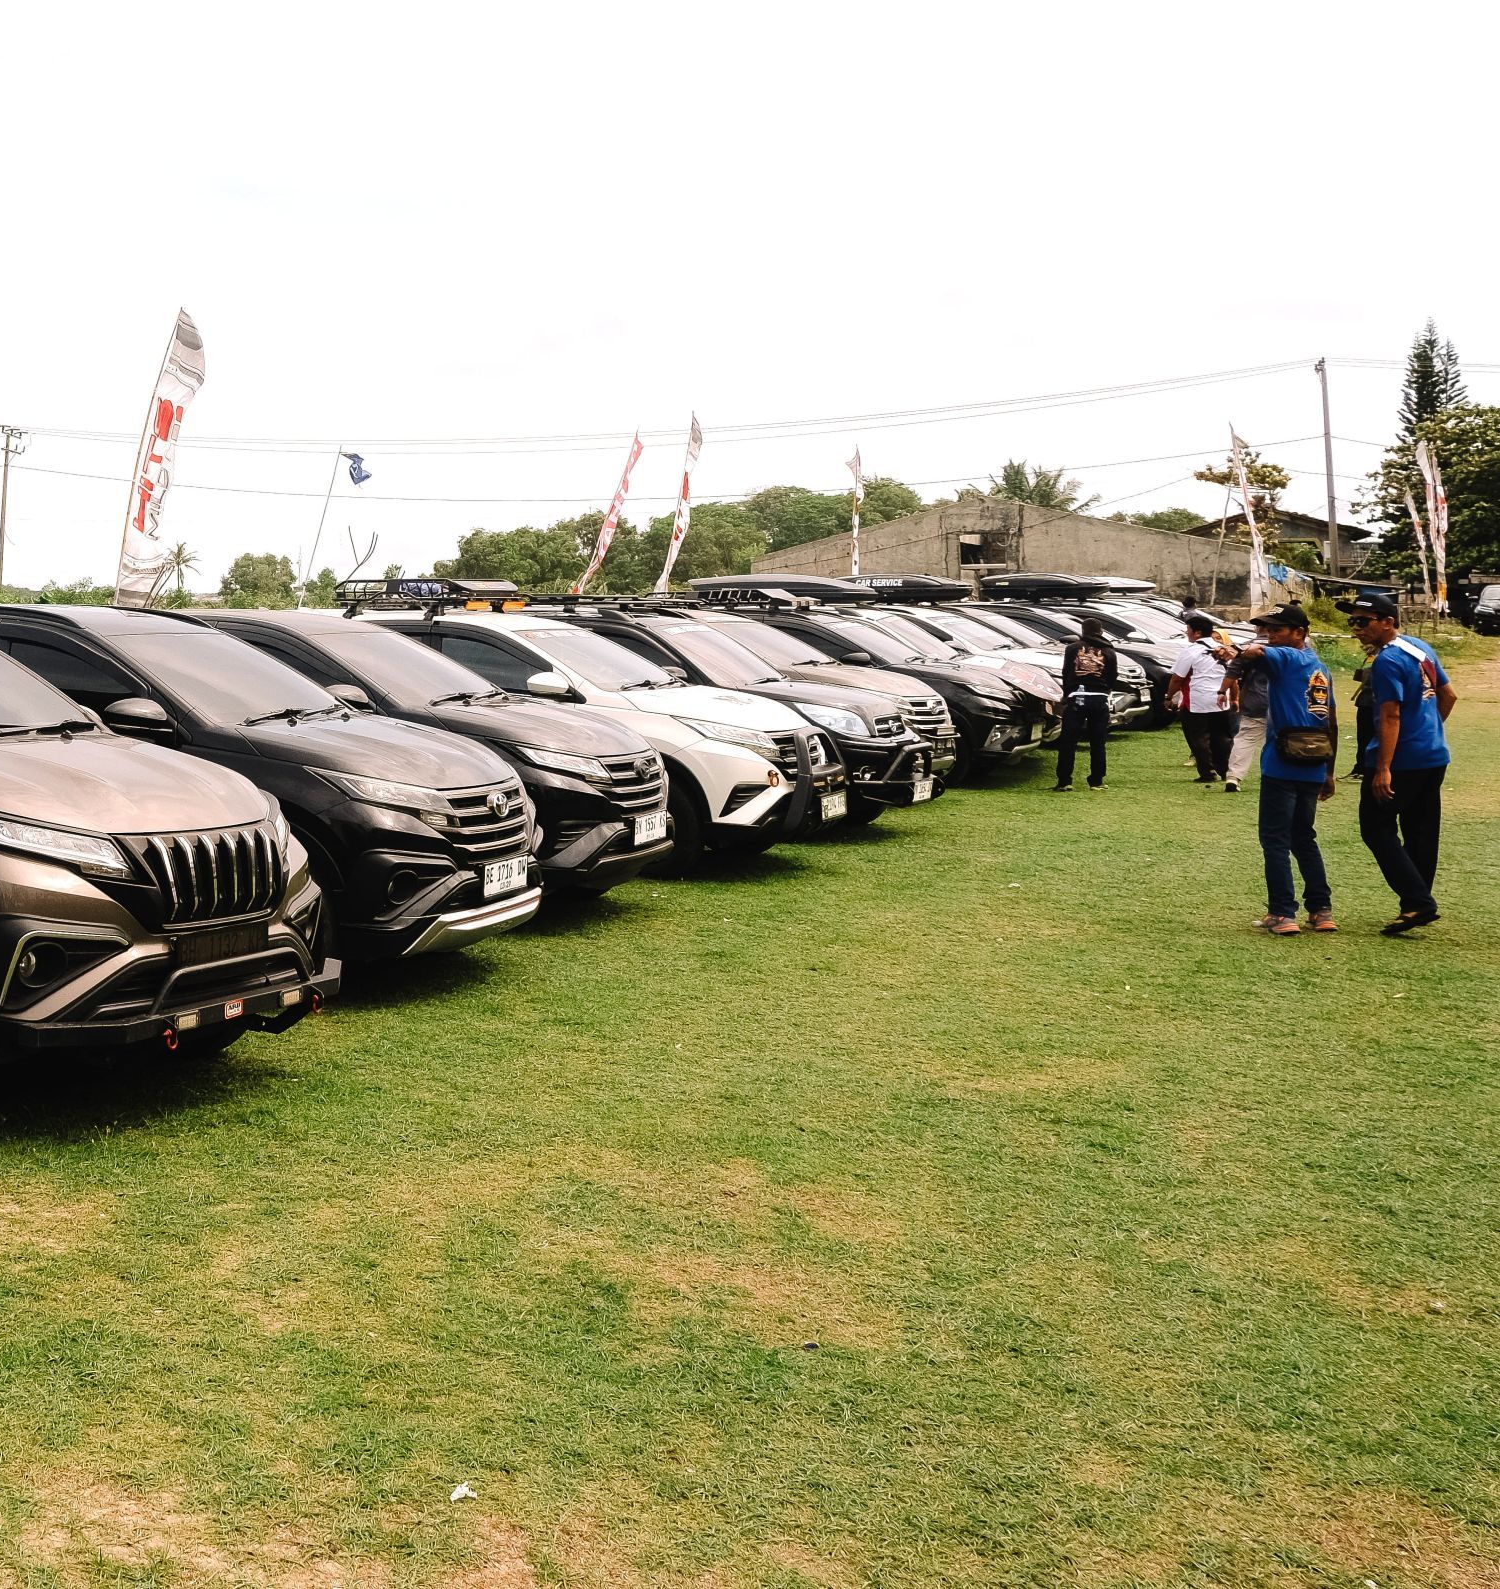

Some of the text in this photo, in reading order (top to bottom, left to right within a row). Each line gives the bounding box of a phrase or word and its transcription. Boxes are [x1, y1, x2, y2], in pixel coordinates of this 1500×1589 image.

[856, 578, 903, 587] CAR SERVICE
[486, 867, 494, 885] BE
[497, 862, 513, 882] 1716
